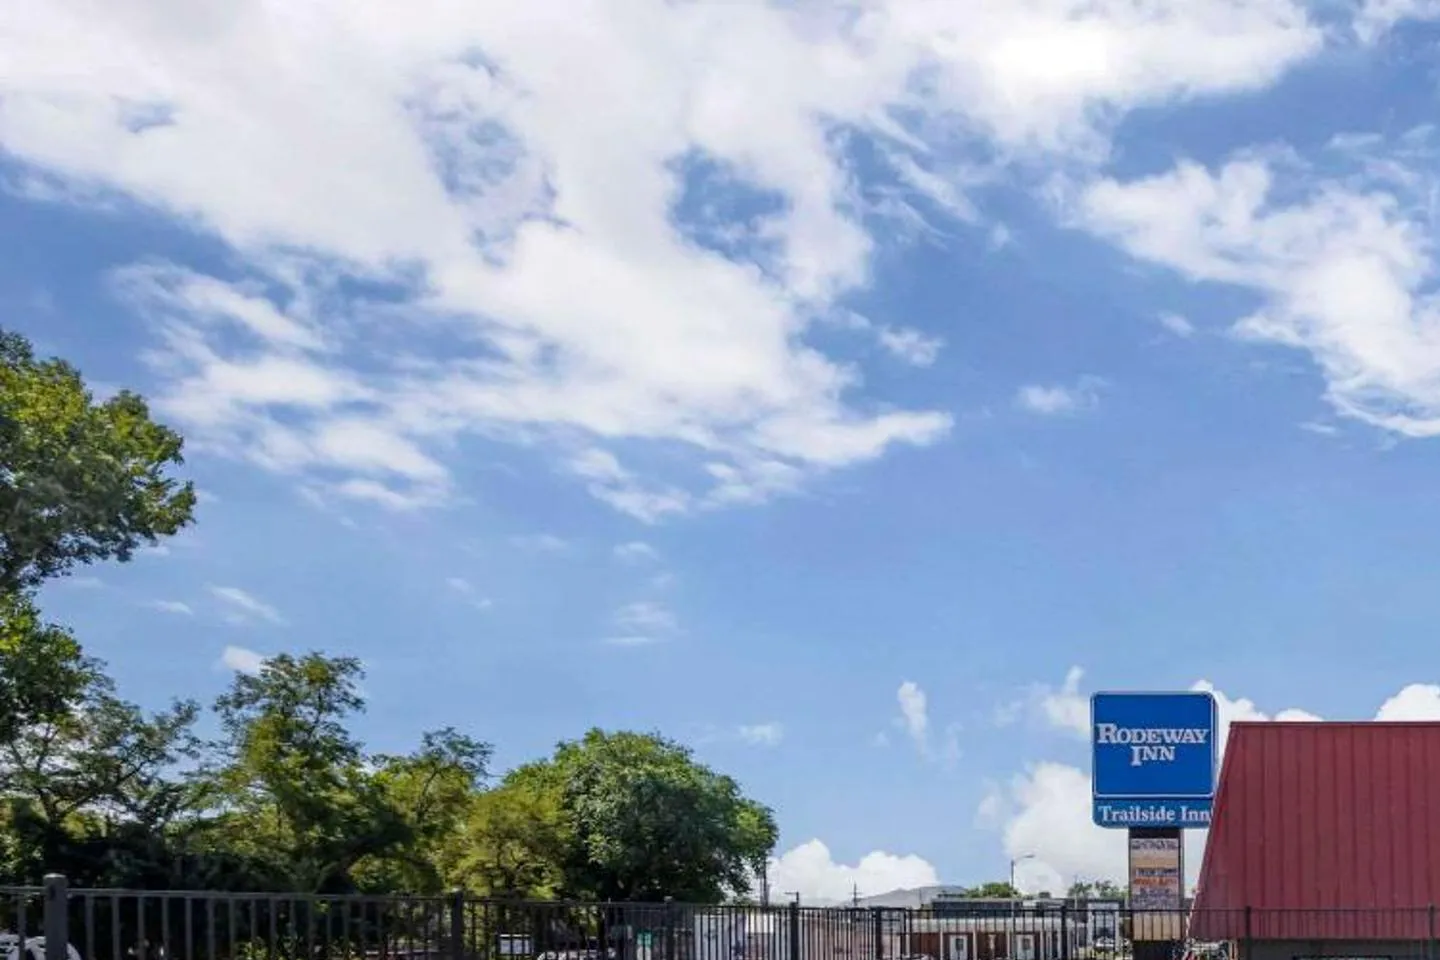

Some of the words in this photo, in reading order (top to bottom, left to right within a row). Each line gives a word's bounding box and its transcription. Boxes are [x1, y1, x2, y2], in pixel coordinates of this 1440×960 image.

[1096, 723, 1210, 744] RODEWAY
[1130, 745, 1175, 767] INN
[1098, 805, 1176, 821] Trailside
[1180, 805, 1210, 821] Inn
